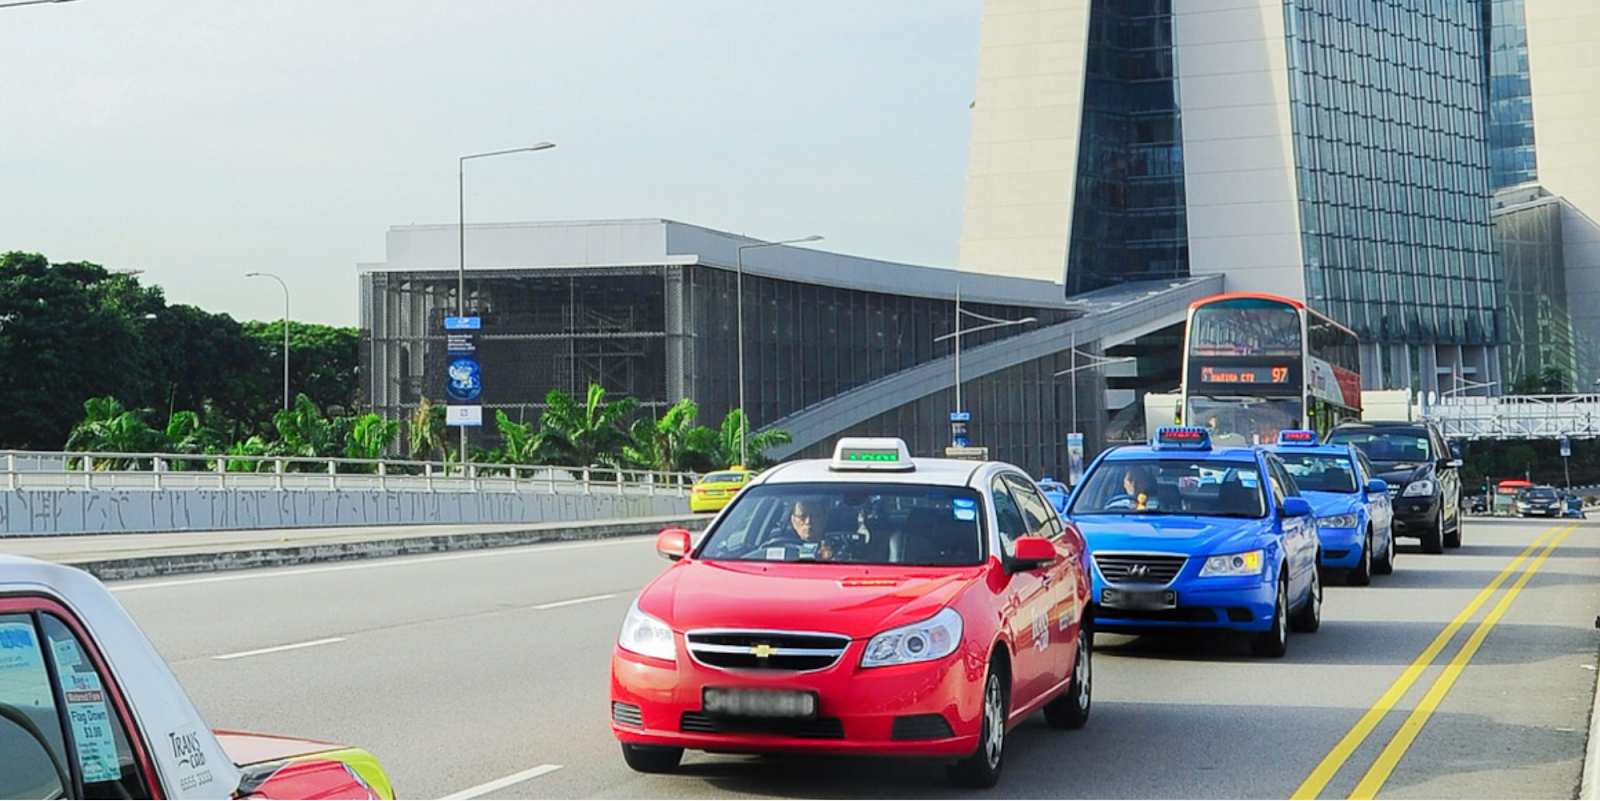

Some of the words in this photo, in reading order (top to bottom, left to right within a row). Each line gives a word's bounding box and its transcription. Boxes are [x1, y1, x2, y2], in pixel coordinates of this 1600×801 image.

[1271, 366, 1288, 382] 97
[71, 711, 88, 725] Flag
[87, 709, 107, 721] Down
[83, 725, 103, 738] $3.00
